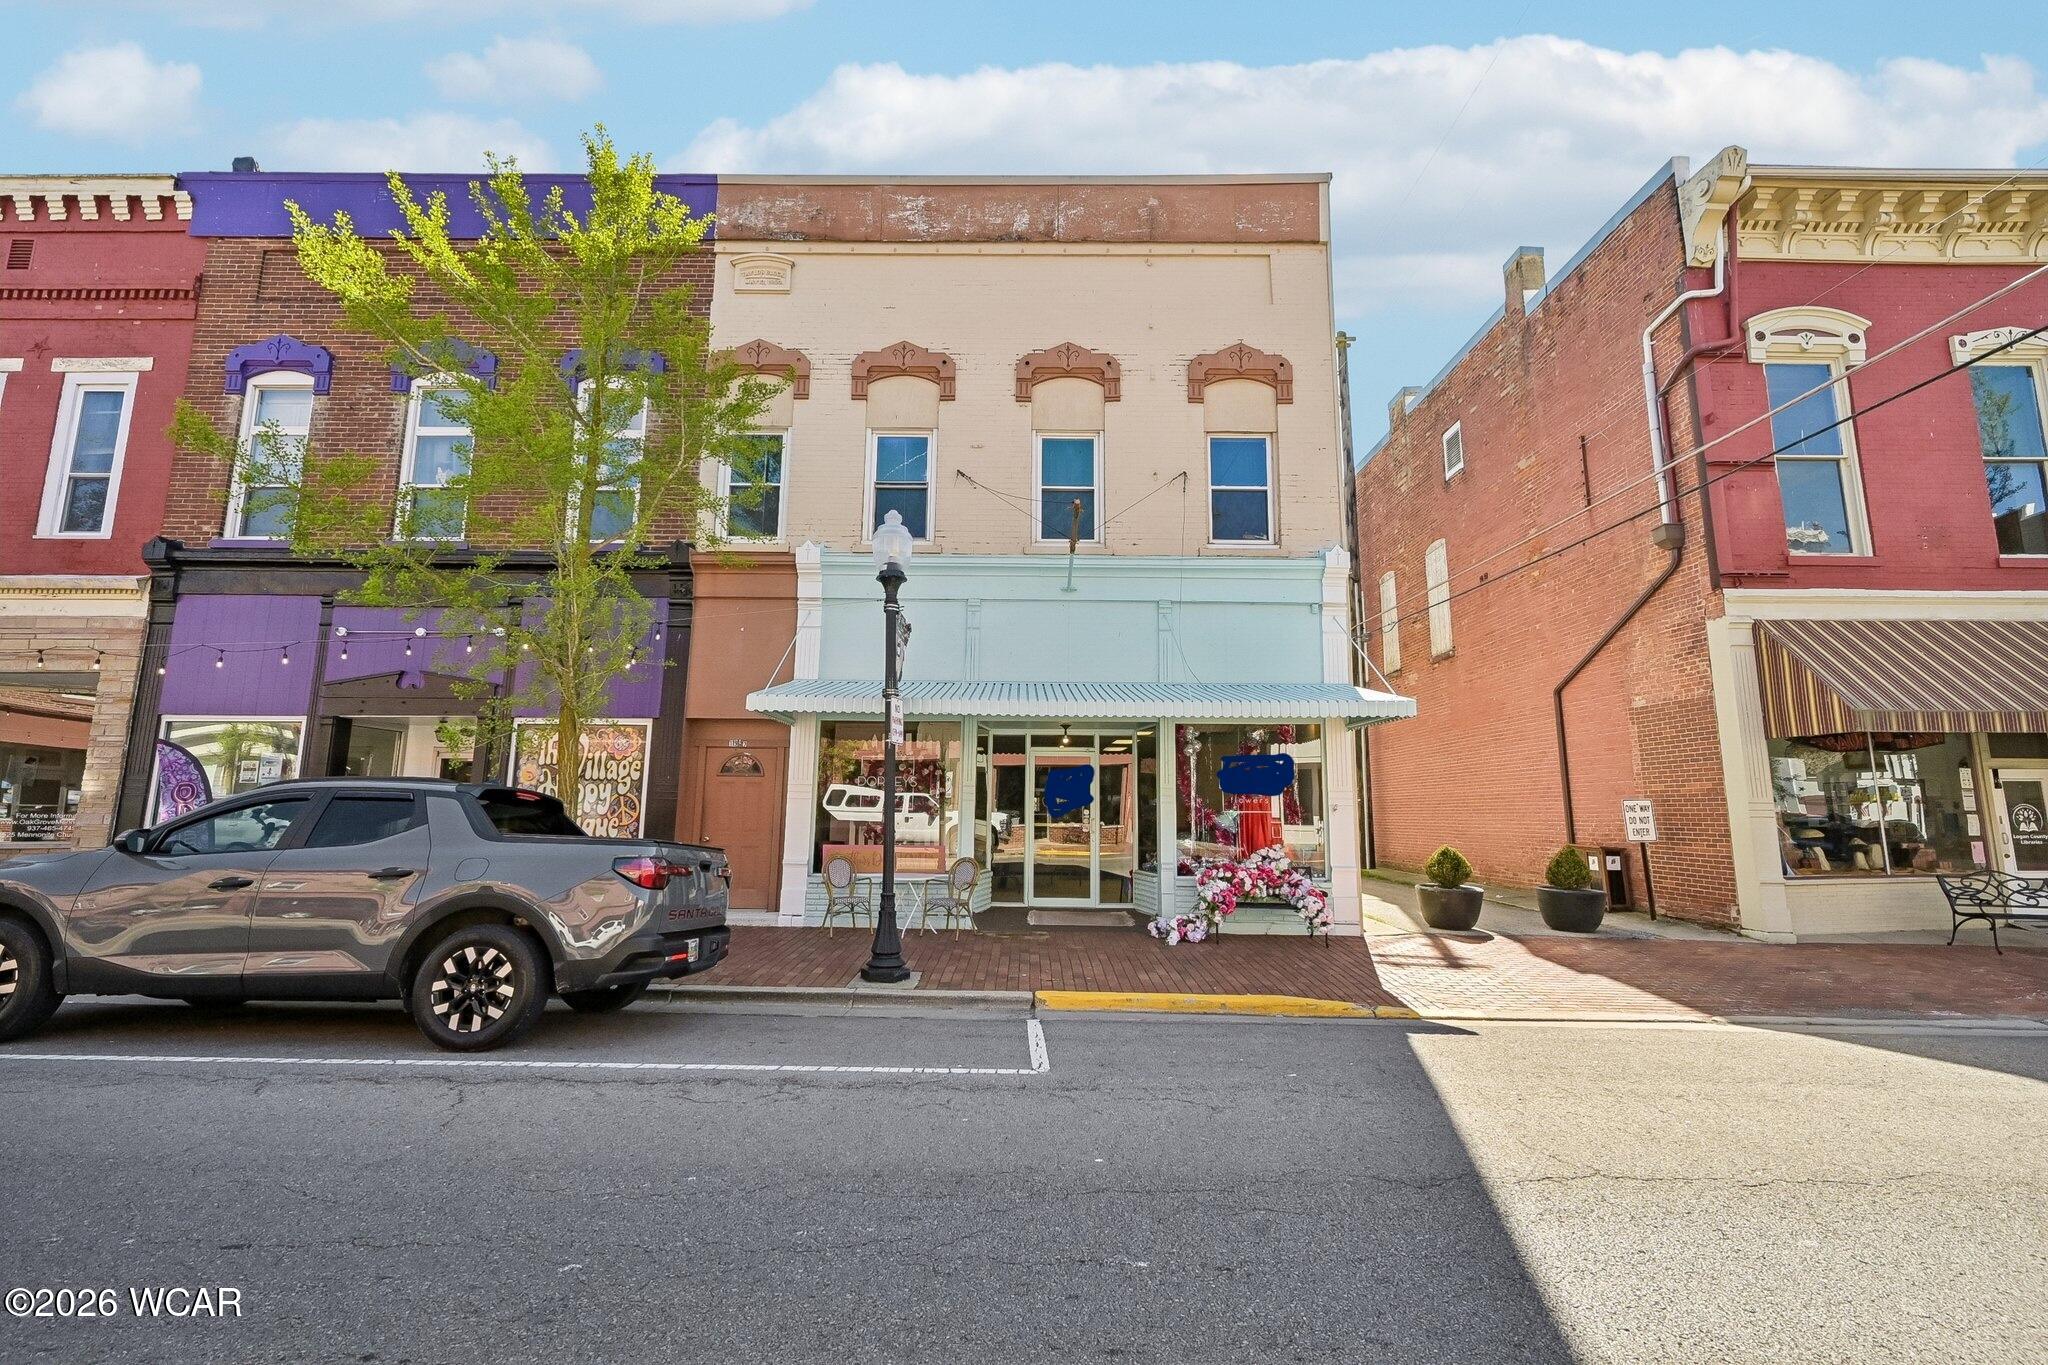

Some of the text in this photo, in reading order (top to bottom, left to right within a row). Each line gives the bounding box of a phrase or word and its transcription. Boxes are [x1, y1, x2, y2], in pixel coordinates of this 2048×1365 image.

[857, 775, 919, 788] DOREYS
[1624, 803, 1651, 813] ONE WAY
[1628, 816, 1650, 825] DO NOT
[1632, 827, 1651, 837] ENTER
